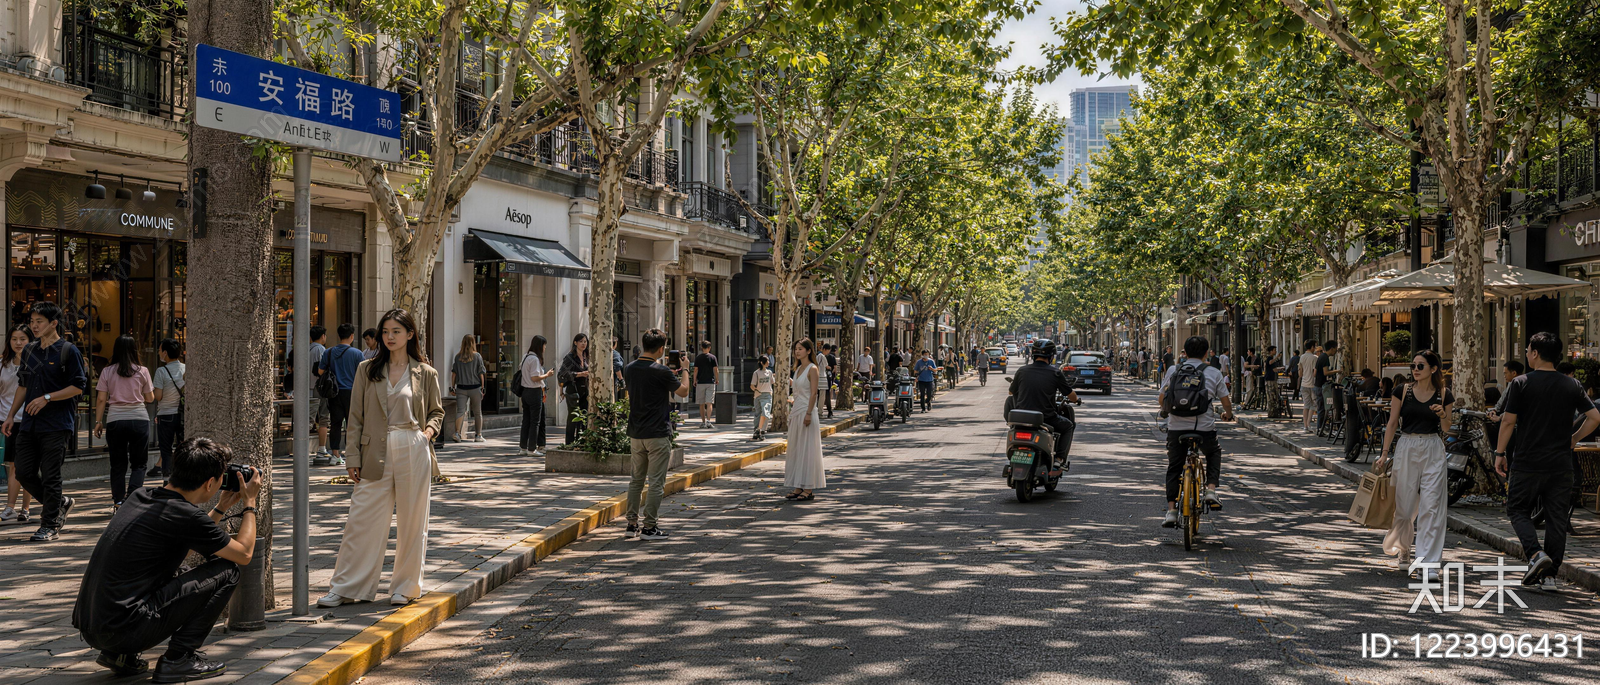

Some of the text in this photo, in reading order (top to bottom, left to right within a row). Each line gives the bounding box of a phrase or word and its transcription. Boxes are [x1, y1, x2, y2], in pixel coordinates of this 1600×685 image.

[209, 79, 231, 95] 100
[258, 70, 355, 121] 安福路
[214, 106, 223, 122] E
[379, 140, 390, 154] W
[121, 213, 174, 231] COMMUNE
